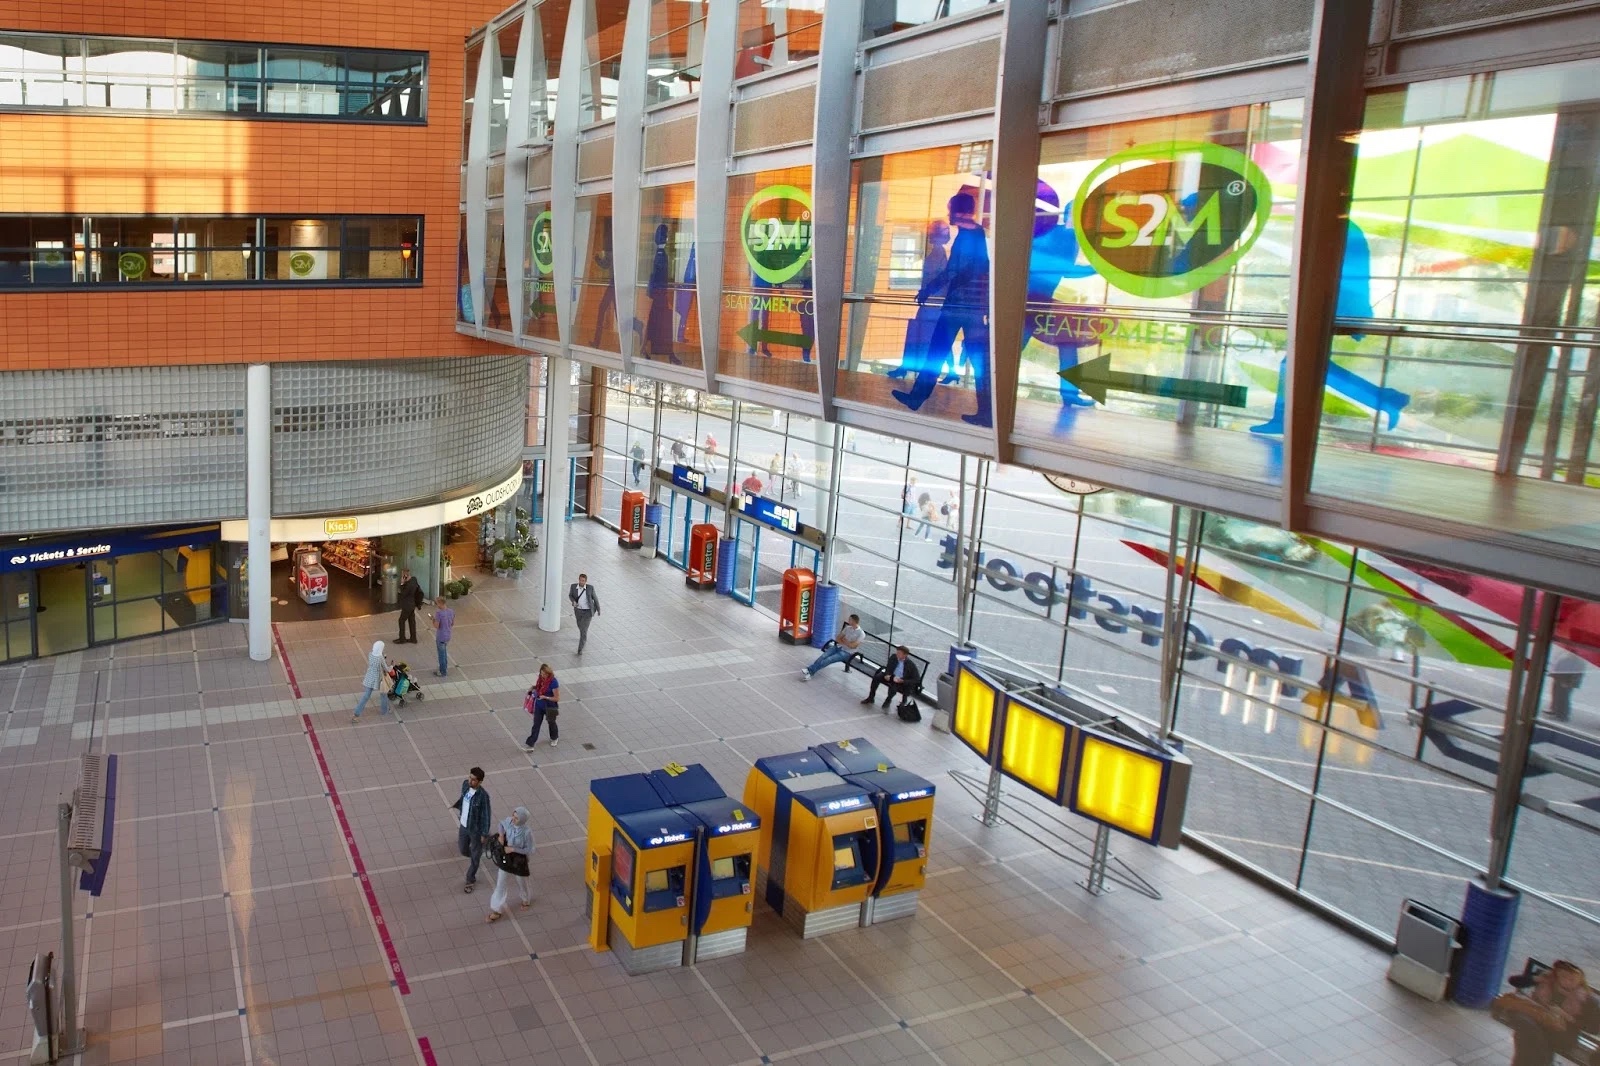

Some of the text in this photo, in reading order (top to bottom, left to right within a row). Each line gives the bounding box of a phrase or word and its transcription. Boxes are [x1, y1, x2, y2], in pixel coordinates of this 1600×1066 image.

[1101, 190, 1222, 250] S2M
[753, 217, 802, 252] S2M
[328, 520, 354, 532] Kiosk
[633, 506, 641, 531] metro
[29, 544, 111, 563] Tickets & Service
[705, 543, 713, 570] metro
[800, 590, 810, 623] metro
[841, 798, 860, 808] Tickets
[731, 821, 753, 831] Tickets
[664, 833, 686, 843] Tickets
